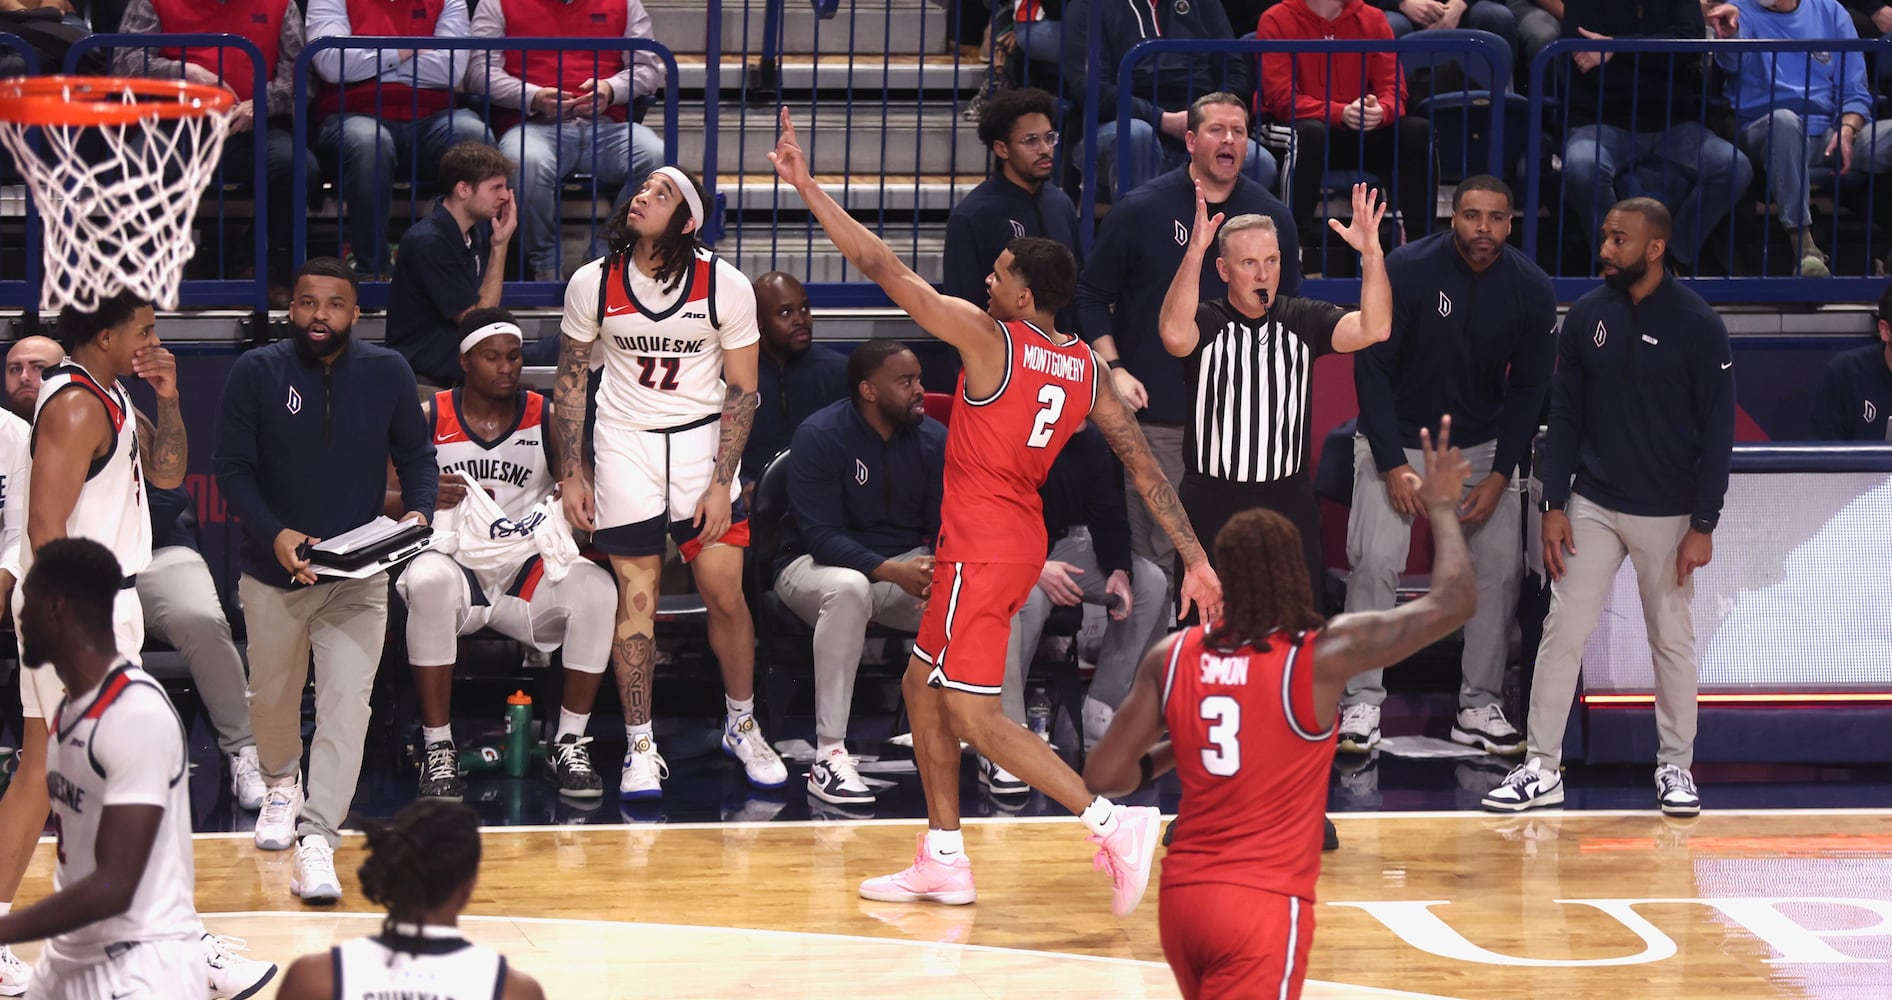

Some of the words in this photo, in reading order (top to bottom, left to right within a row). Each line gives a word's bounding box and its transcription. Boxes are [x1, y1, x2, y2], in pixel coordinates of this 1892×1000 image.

[612, 334, 707, 354] DUQUESNE
[636, 356, 681, 391] 22
[1022, 343, 1086, 383] MONTGOMERY
[1026, 383, 1067, 449] 2
[1200, 652, 1249, 685] SIMON
[1199, 694, 1241, 777] 3
